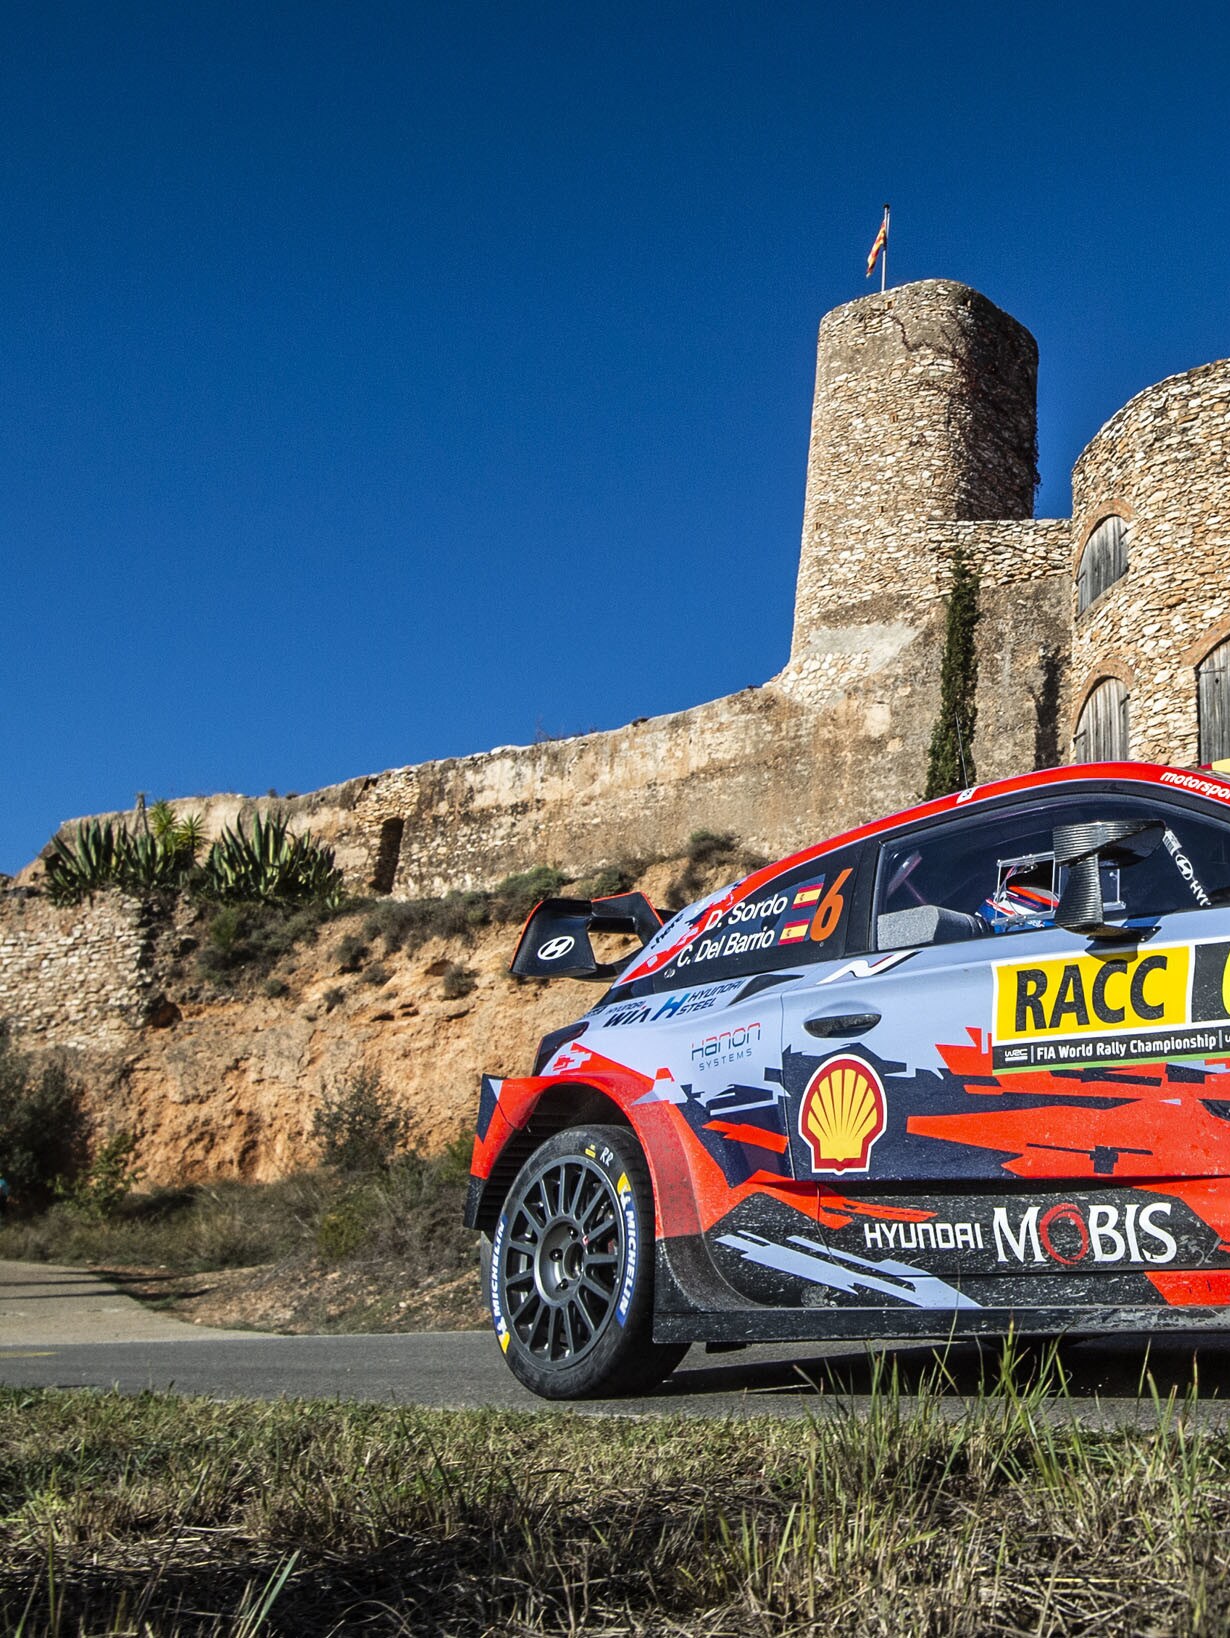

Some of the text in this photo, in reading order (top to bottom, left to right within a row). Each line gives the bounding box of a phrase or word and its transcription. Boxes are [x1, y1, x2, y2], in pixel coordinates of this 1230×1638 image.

[704, 894, 788, 931] D. Sordo
[809, 867, 853, 942] 6
[676, 925, 775, 968] C. Del Barrio
[676, 997, 717, 1016] STEEL
[688, 979, 747, 1002] HYUNDAI
[1015, 954, 1168, 1032] RACC
[602, 1005, 652, 1028] WIA
[699, 1048, 753, 1072] SYSTEMS
[1036, 1045, 1056, 1061] FIA
[1058, 1042, 1093, 1060] World
[1096, 1040, 1127, 1057] Rally
[1129, 1033, 1217, 1054] Championship
[864, 1202, 1178, 1266] HYUNDAI MOBIS
[491, 1221, 506, 1317] MICHELIN
[619, 1210, 638, 1316] MICHELIN
